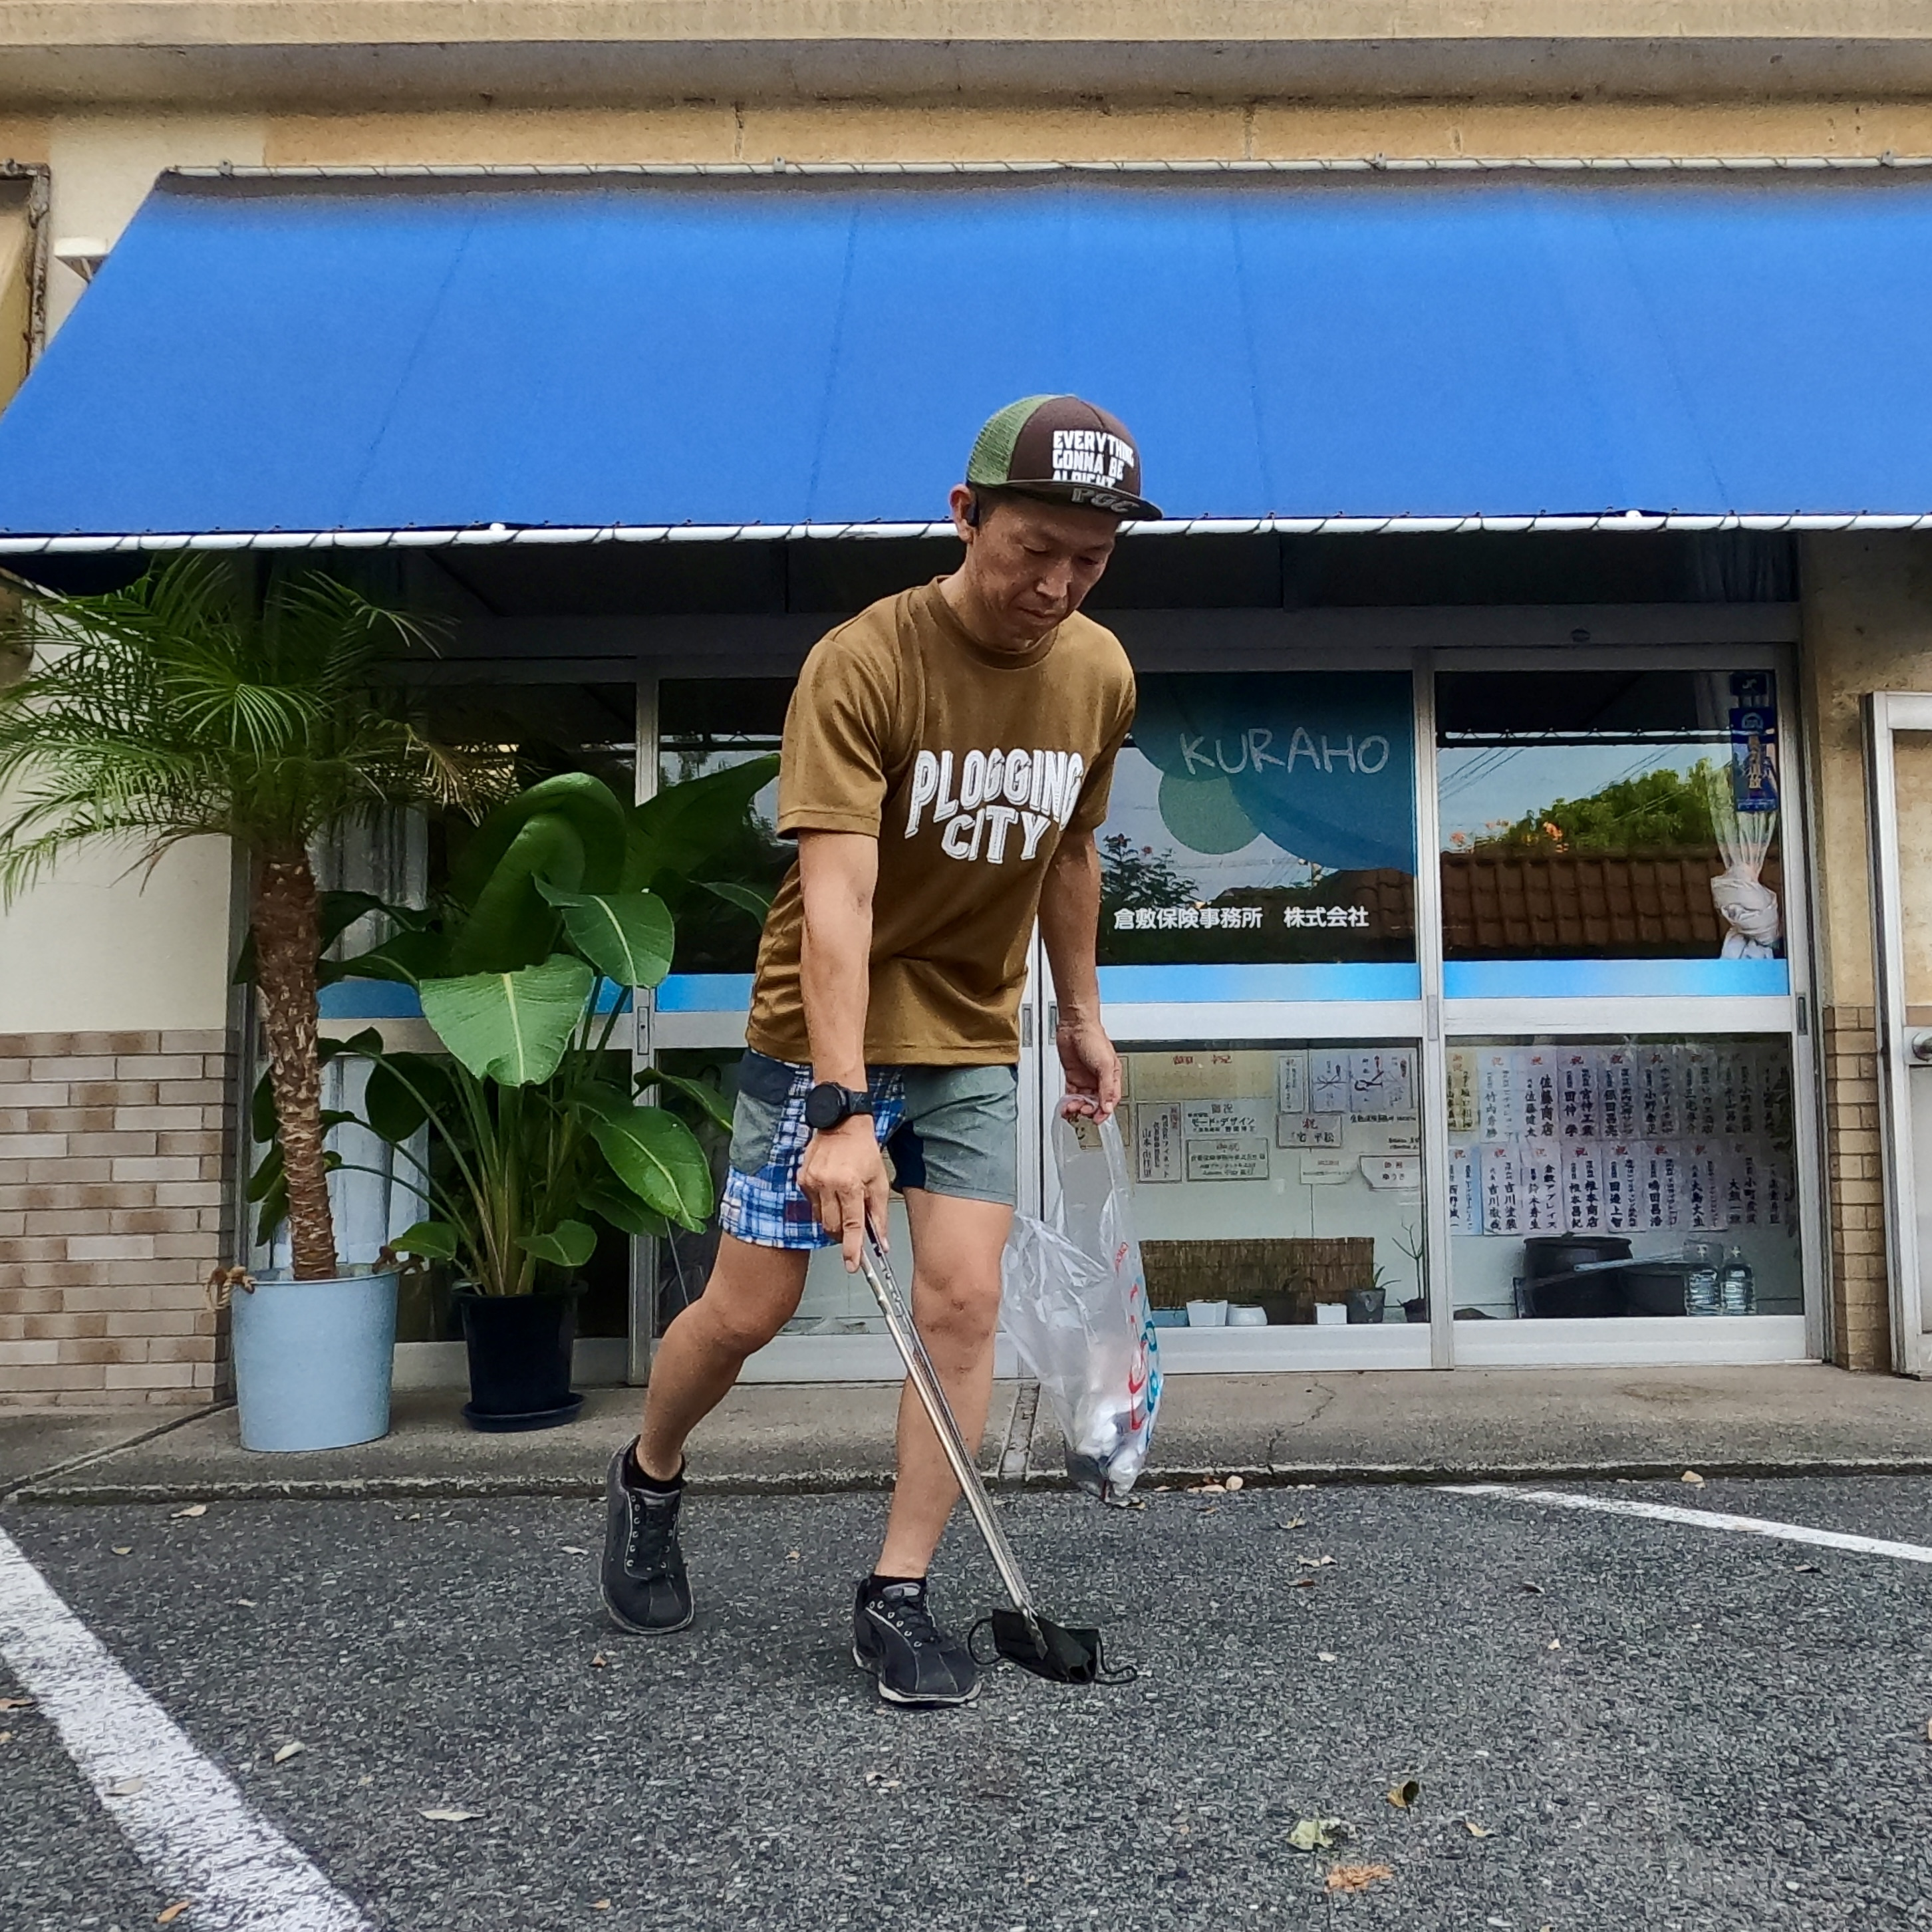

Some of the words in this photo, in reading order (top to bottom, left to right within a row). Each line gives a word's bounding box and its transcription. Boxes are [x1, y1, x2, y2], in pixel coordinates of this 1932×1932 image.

[1052, 430, 1135, 468] EVERYTHING
[1052, 450, 1105, 475] GONNA
[1109, 456, 1125, 481] BE
[1178, 726, 1390, 775] KURAHO
[904, 748, 1084, 839] PLOGGING
[941, 805, 1051, 864] CITY
[1113, 906, 1264, 930] 倉敷保険事務所
[1284, 905, 1370, 929] 株式会社
